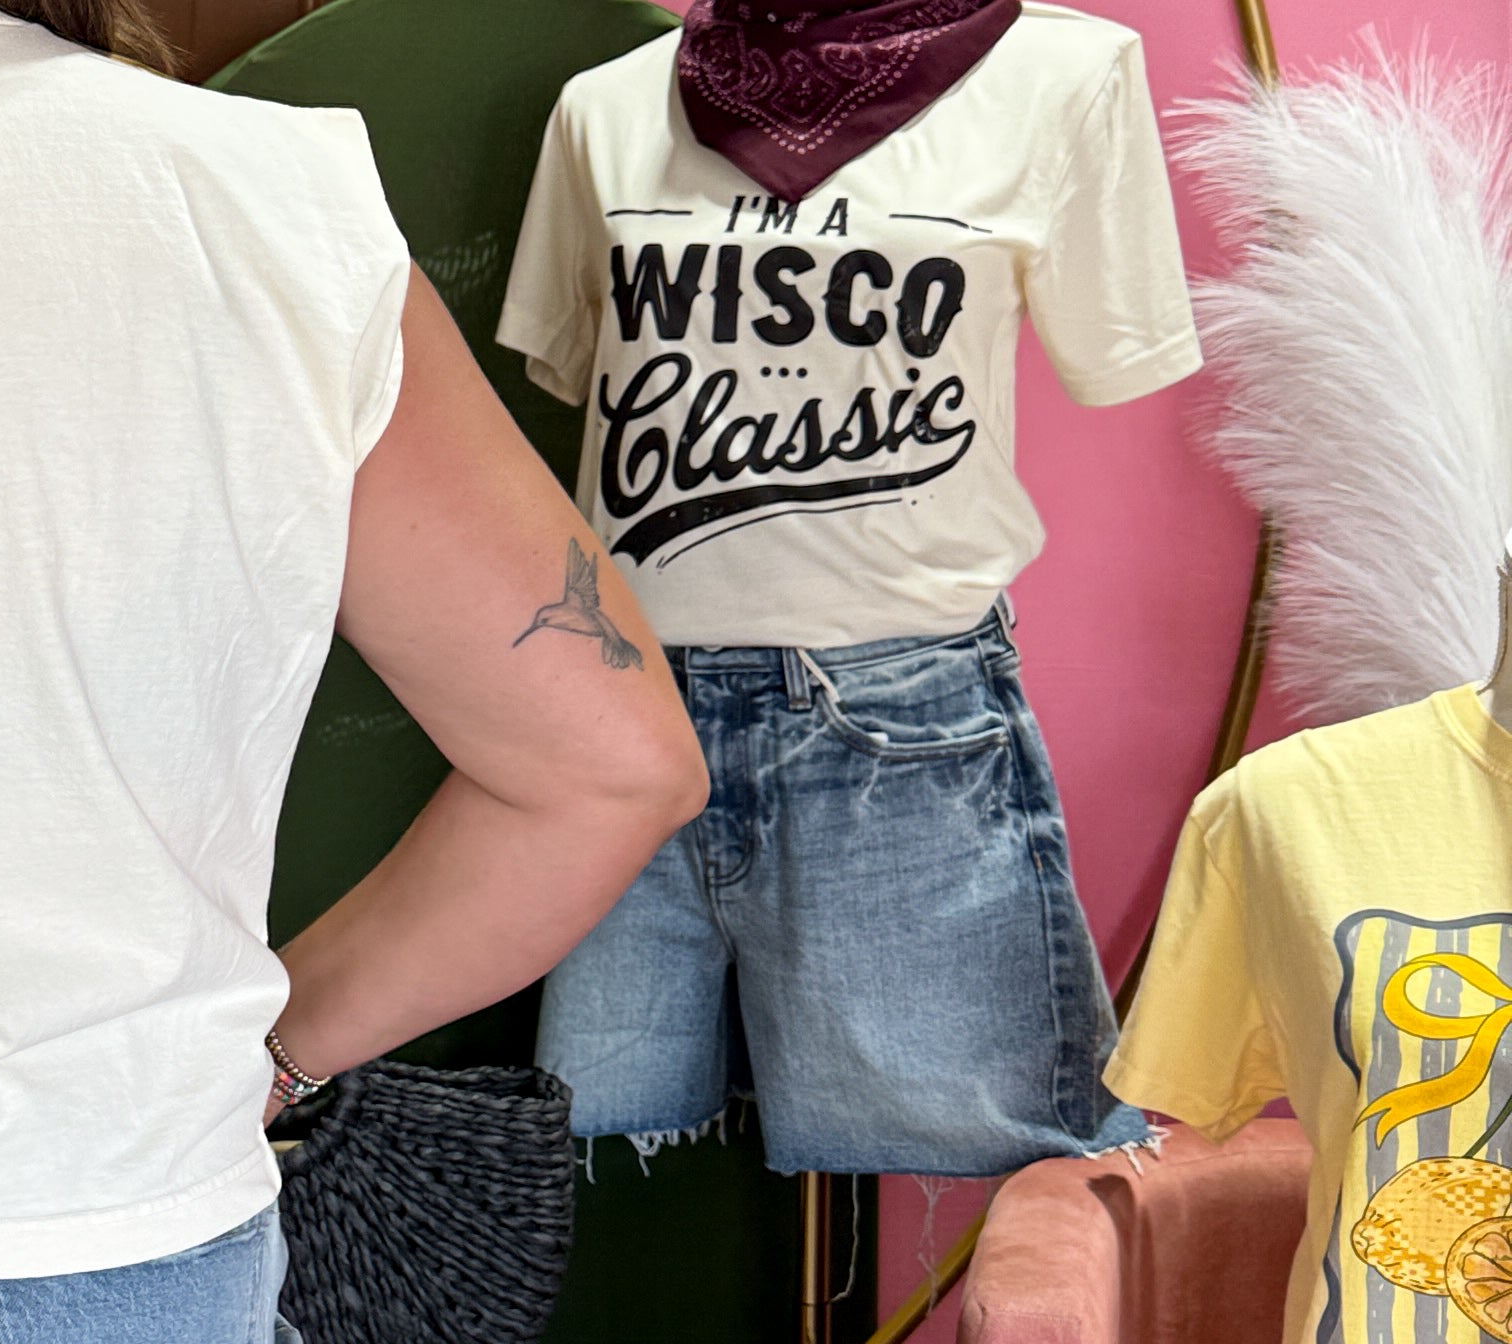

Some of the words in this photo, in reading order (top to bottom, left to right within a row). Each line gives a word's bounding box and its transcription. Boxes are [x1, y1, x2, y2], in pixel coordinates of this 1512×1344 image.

[724, 196, 798, 233] I'M
[816, 197, 849, 236] A
[610, 244, 966, 359] WISCO
[599, 353, 976, 520] Classic
